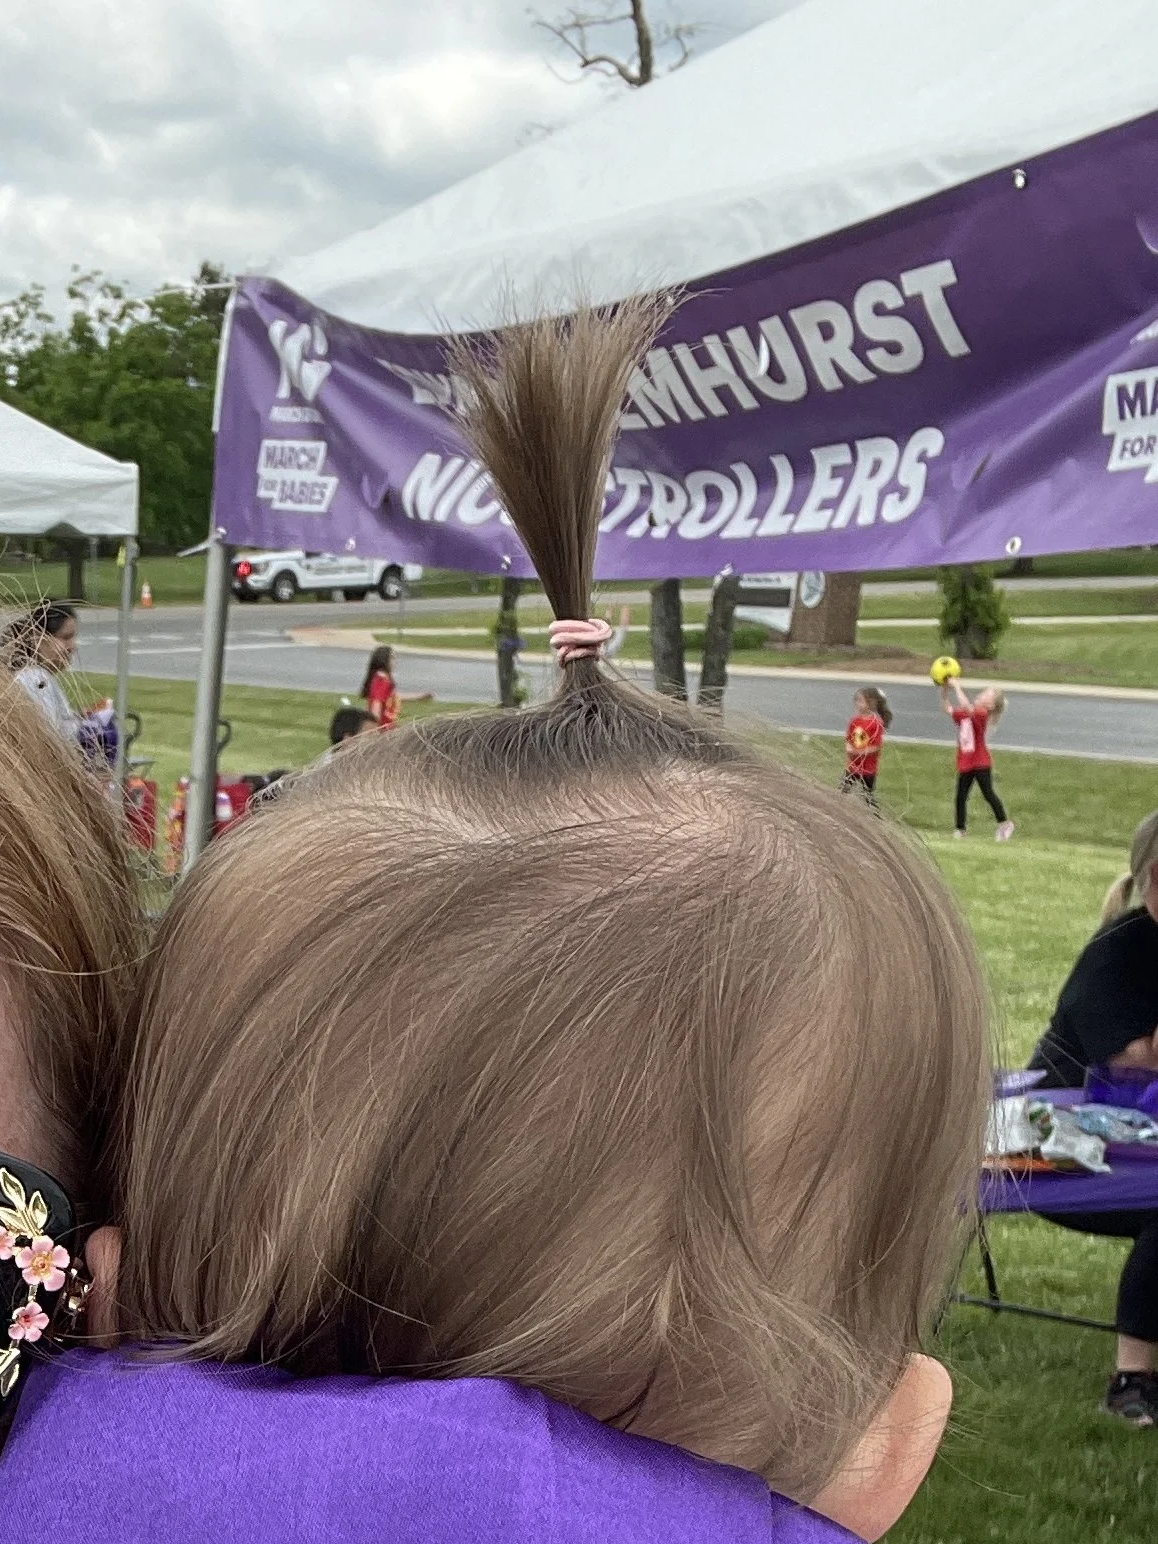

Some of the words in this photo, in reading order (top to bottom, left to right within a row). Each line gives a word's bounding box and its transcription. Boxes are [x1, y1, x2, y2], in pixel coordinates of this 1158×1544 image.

[617, 259, 971, 431] MHURST
[401, 452, 516, 527] NIC
[598, 427, 946, 541] TROLLERS
